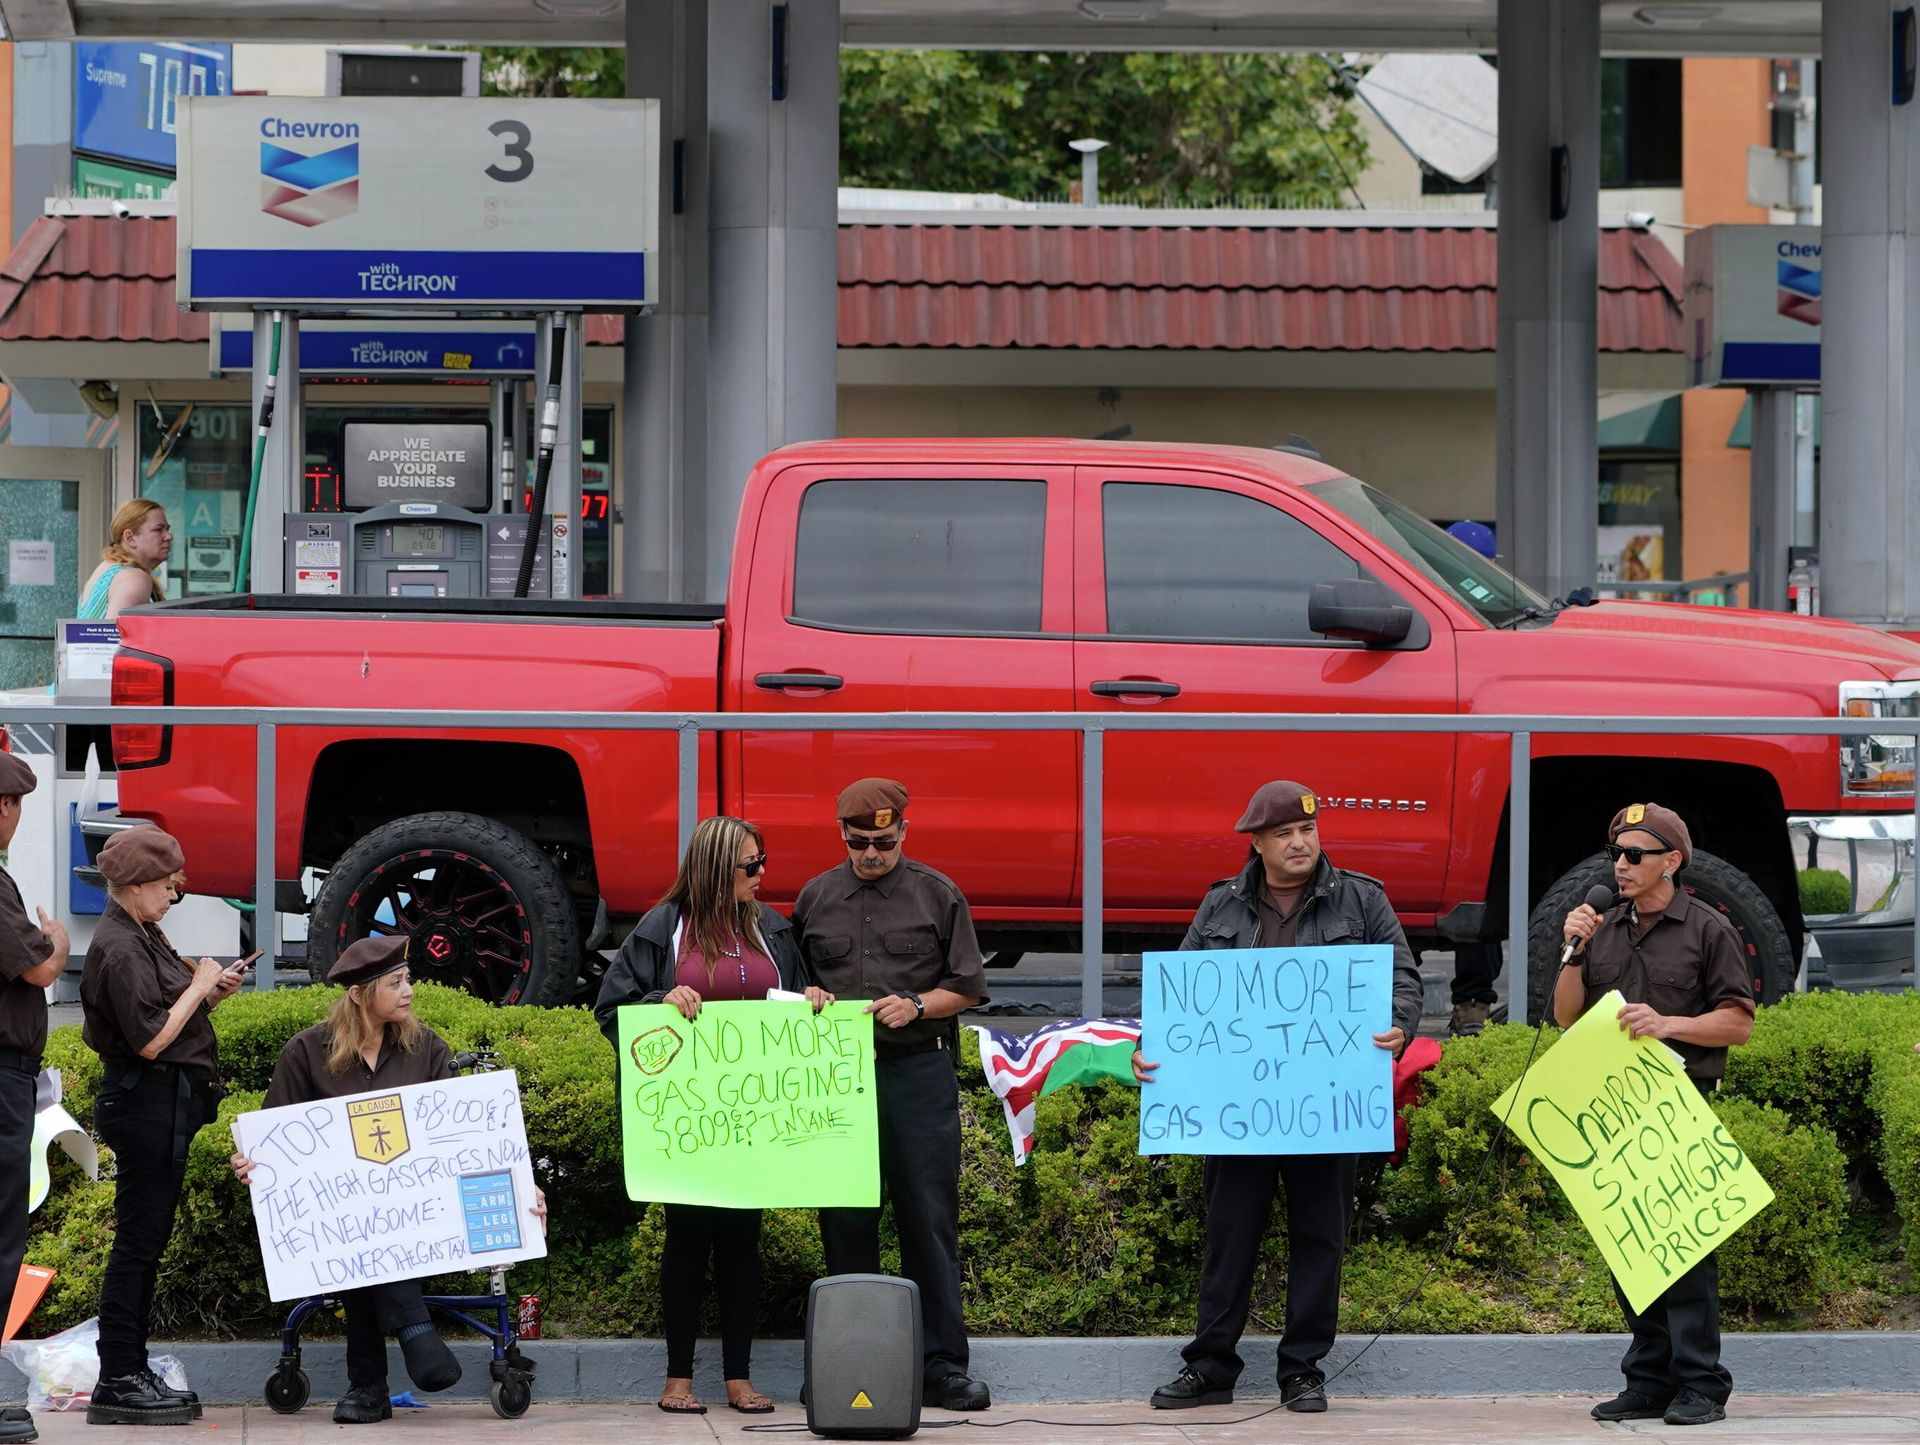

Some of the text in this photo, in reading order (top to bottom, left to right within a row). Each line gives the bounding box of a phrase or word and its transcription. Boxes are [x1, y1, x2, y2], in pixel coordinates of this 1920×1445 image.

[86, 63, 127, 88] Supreme
[260, 117, 359, 138] Chevron
[484, 119, 534, 183] 3
[1777, 241, 1822, 257] Chev
[369, 263, 400, 275] with
[358, 271, 456, 295] TECHRON
[351, 347, 428, 366] TECHRON
[359, 341, 384, 351] with
[402, 437, 430, 449] WE
[367, 450, 466, 462] APPRECIATE
[392, 463, 437, 475] YOUR
[377, 475, 456, 488] BUSINESS
[1599, 483, 1663, 505] BWAY
[191, 501, 214, 527] A
[406, 505, 431, 513] Chevron
[1317, 796, 1427, 812] LVERADO
[1159, 957, 1375, 1016] NO MORE
[693, 1015, 855, 1070] NO MORE
[1166, 1017, 1362, 1057] GAS TAX
[638, 1034, 674, 1067] STOP
[1253, 1058, 1289, 1081] or
[352, 1098, 397, 1114] LA CAUSA
[636, 1077, 707, 1116] GAS
[760, 1103, 854, 1143] INSANE
[1142, 1102, 1203, 1140] GAS
[249, 1106, 334, 1193] STOP
[1593, 1085, 1698, 1212] STOP!
[259, 1178, 311, 1232] THE
[309, 1169, 366, 1213] HIGH
[368, 1163, 416, 1195] GAS
[487, 1139, 530, 1170] NOW
[480, 1194, 506, 1208] ARM
[483, 1213, 508, 1226] LEG
[270, 1222, 323, 1263] HEY
[486, 1231, 513, 1246] Both
[311, 1247, 389, 1288] LOWER
[415, 1240, 444, 1265] GAS
[440, 1235, 468, 1260] TAX
